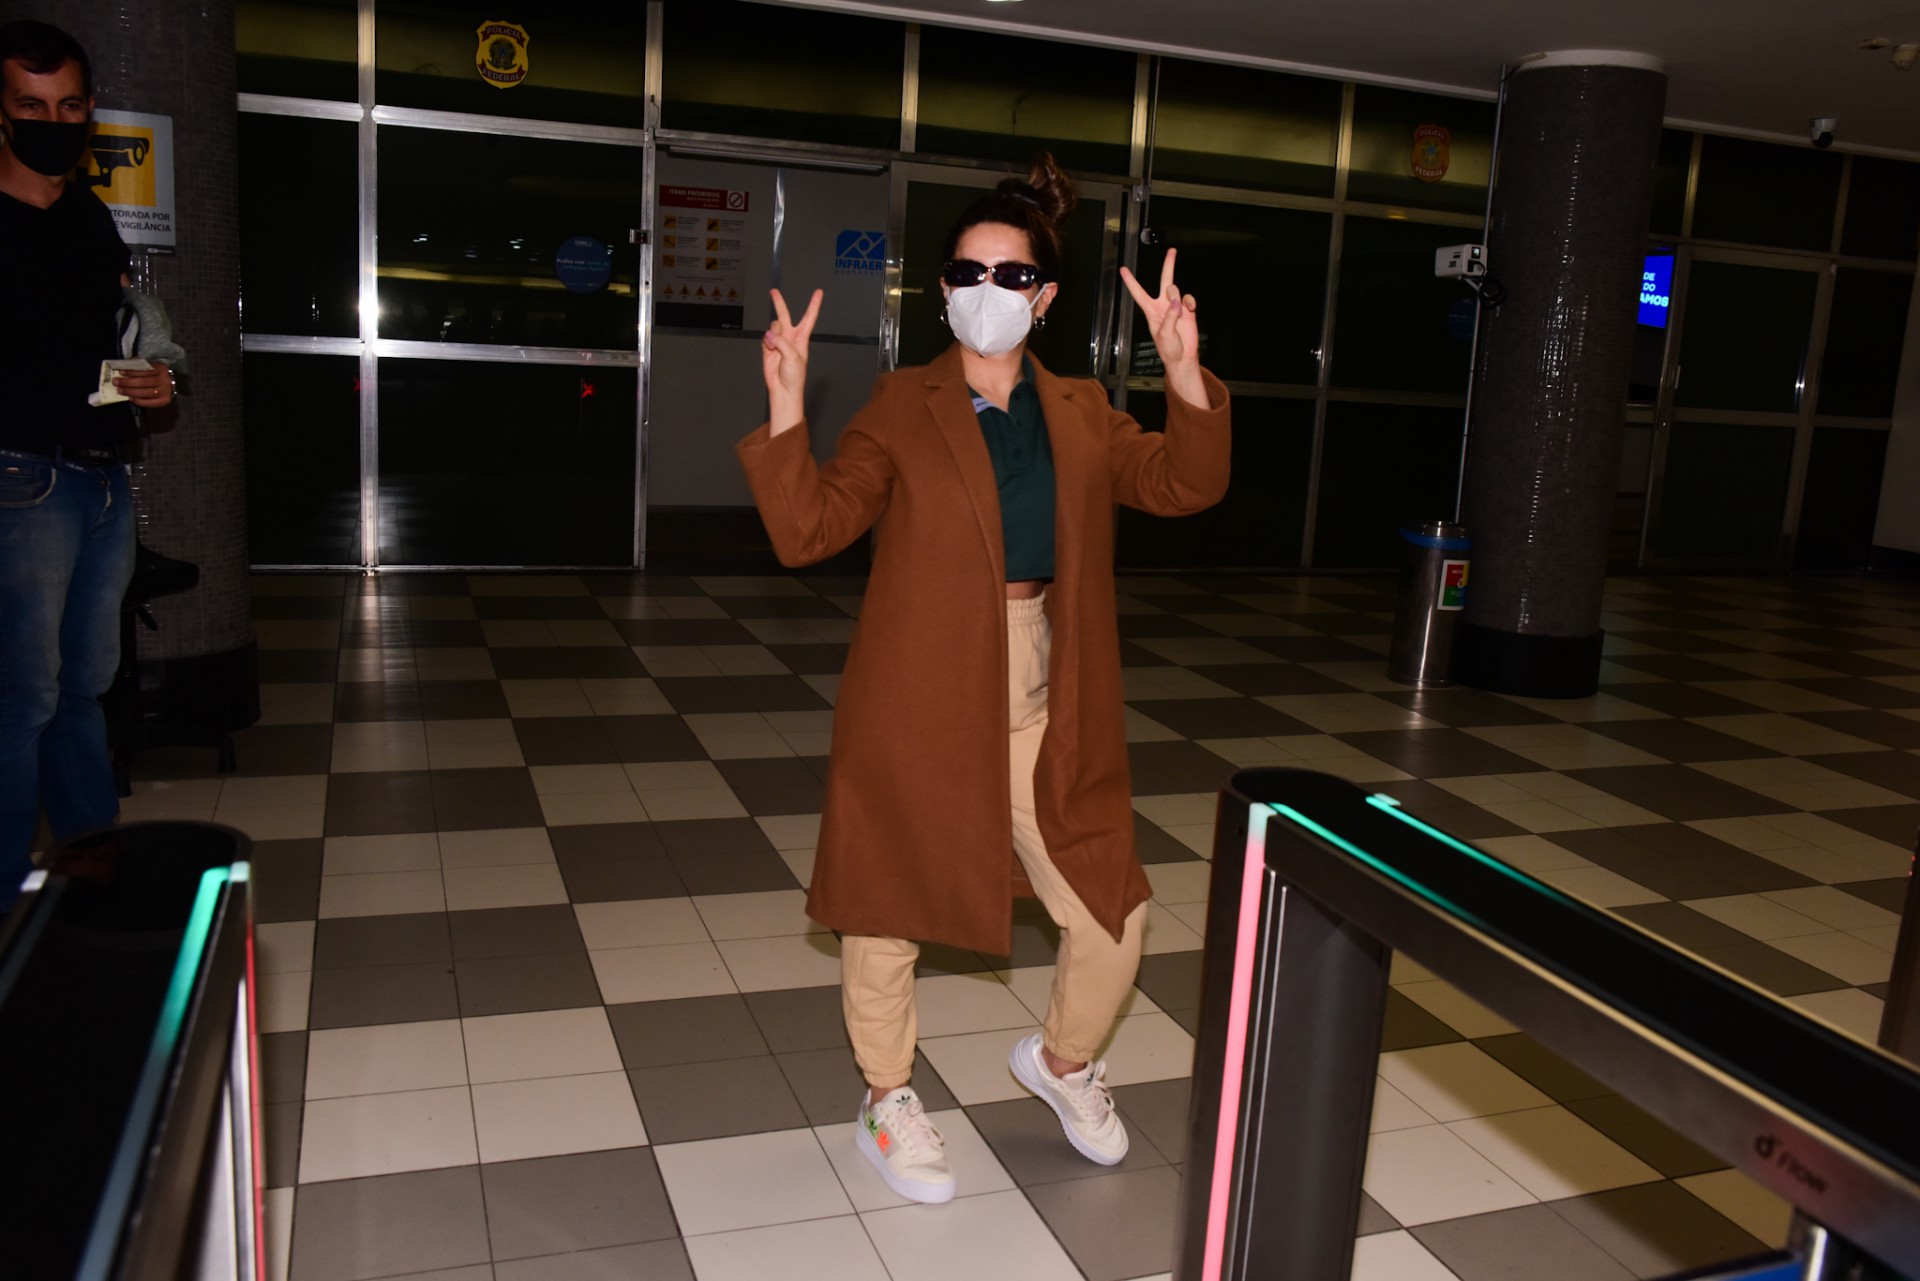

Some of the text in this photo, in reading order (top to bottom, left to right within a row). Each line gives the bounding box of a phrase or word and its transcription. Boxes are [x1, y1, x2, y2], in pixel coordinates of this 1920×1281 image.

[482, 67, 521, 82] FEDERAL
[111, 209, 170, 221] TORADA POR
[120, 221, 171, 232] VIGILÂNCIA
[835, 258, 885, 271] INFRAER
[1643, 272, 1656, 281] DE
[1643, 282, 1656, 292] DO
